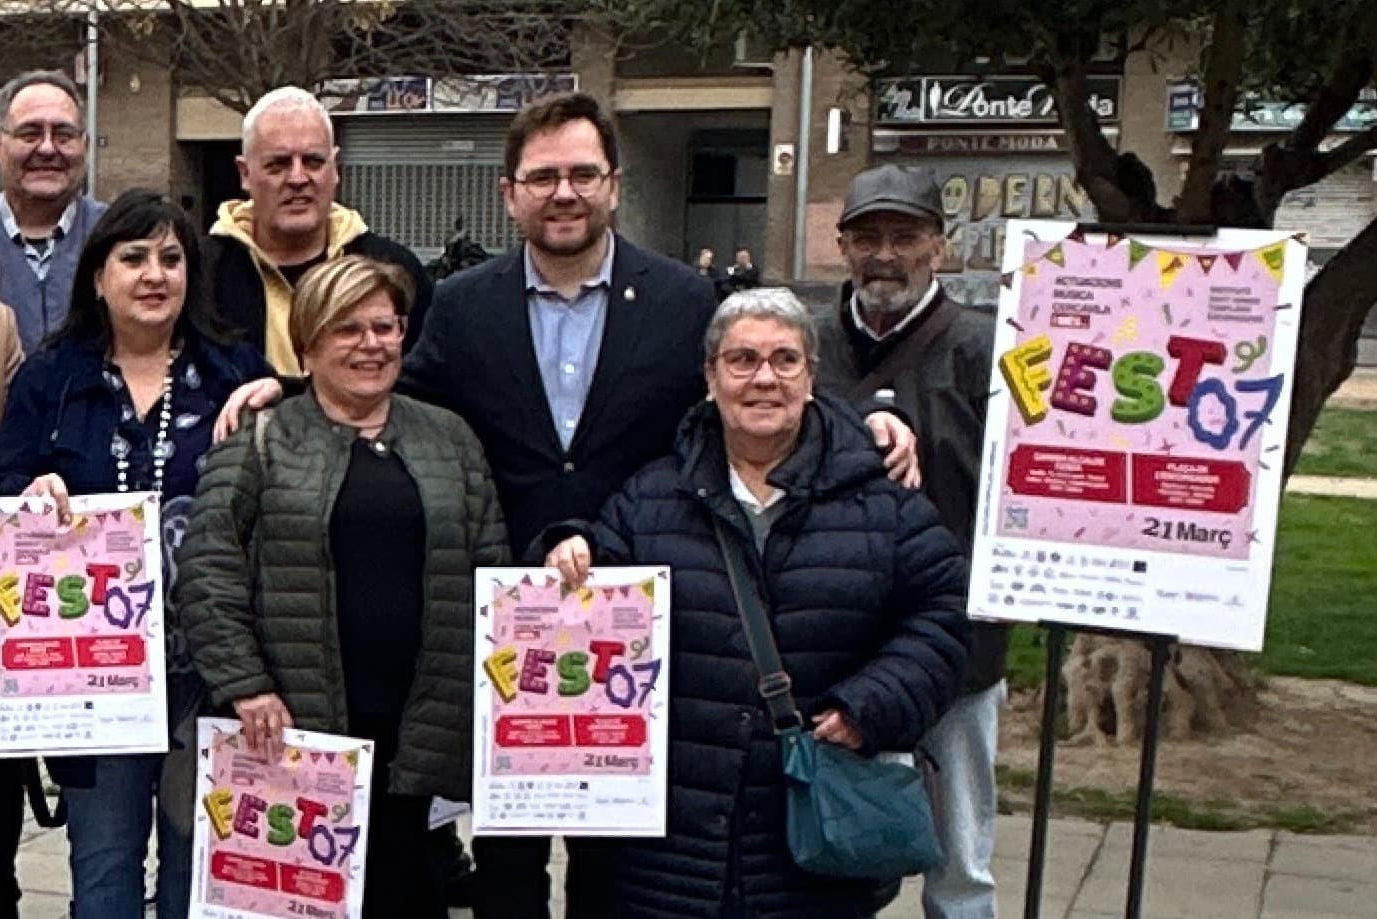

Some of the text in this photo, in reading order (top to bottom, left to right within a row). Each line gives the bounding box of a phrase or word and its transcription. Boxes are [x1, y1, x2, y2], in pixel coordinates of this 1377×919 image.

[999, 333, 1285, 451] FEST 07
[1141, 516, 1232, 550] 21 Març
[103, 579, 155, 630] 07
[482, 640, 662, 709] FEST 07
[202, 788, 360, 867] FEST 07
